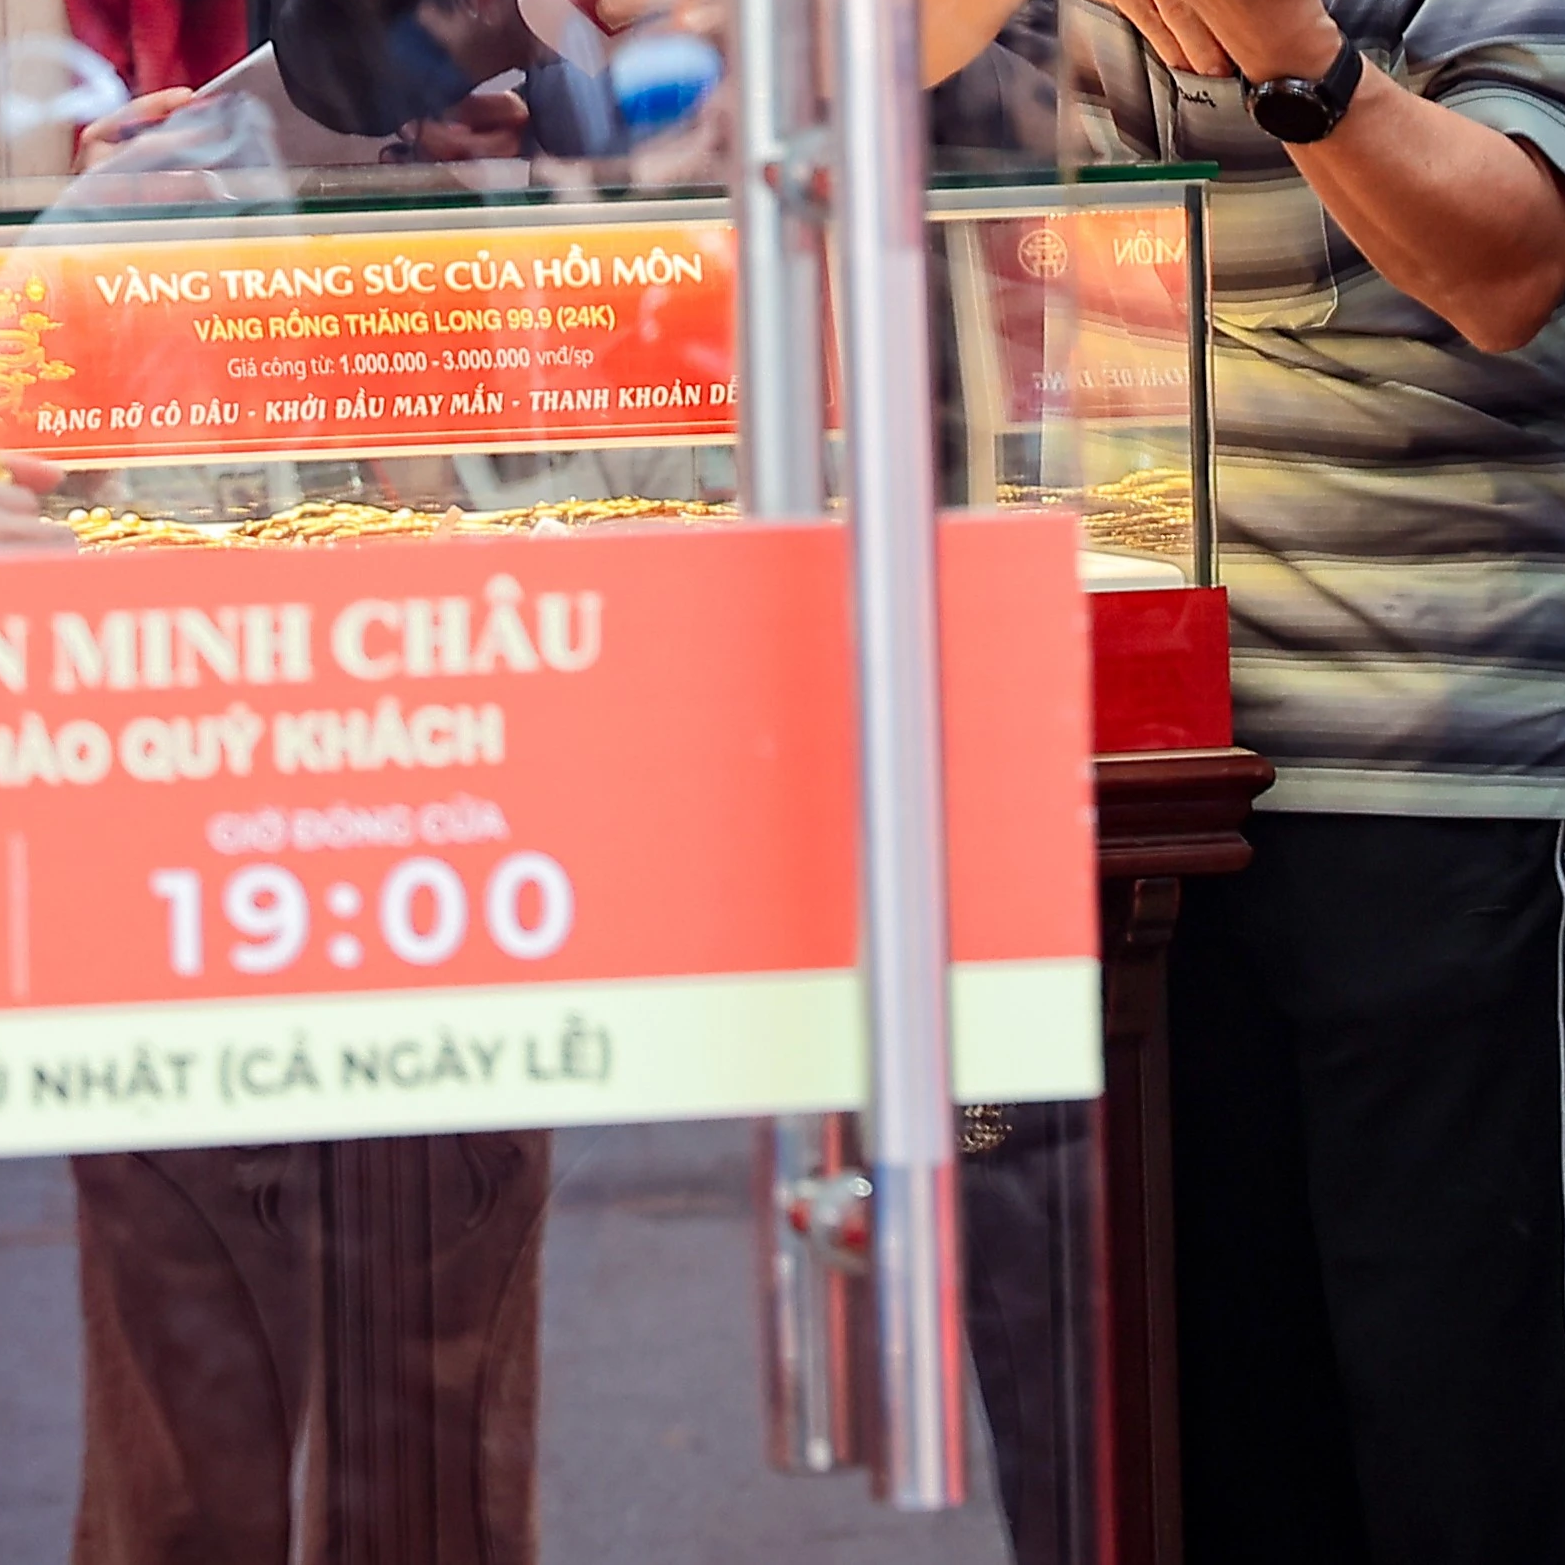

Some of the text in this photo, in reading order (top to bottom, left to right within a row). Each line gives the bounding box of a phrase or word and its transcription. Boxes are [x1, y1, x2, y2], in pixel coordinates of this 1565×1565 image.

[95, 242, 704, 306] VÀNG TRANG SỨC CỦA HỒI MÔN
[193, 303, 617, 344] VÀNG RỒNG THĂNG LONG 99.9 (24K)
[226, 355, 258, 380] Giá
[261, 355, 307, 382] công
[339, 350, 429, 376] 1.000.000
[442, 346, 531, 372] 3.000.000
[36, 408, 103, 438] RẠNG
[110, 399, 146, 430] RỠ
[149, 399, 189, 429] CÔ
[191, 395, 241, 426] DÂU
[265, 391, 327, 424] KHỞI
[334, 386, 386, 420] ĐẦU
[391, 392, 443, 419] MAY
[449, 380, 505, 416] MẮN
[529, 387, 611, 414] THANH
[618, 377, 703, 408] KHOẢN
[51, 601, 315, 694] MINH
[331, 572, 605, 682] CHÂU
[118, 700, 265, 783] QUÝ
[272, 694, 505, 776] KHÁCH
[148, 848, 576, 979] 19:00
[29, 1041, 196, 1124] NHẬT
[217, 1029, 320, 1106] (CẢ
[338, 1019, 510, 1087] NGÀY
[525, 1007, 614, 1084] LỄ)
